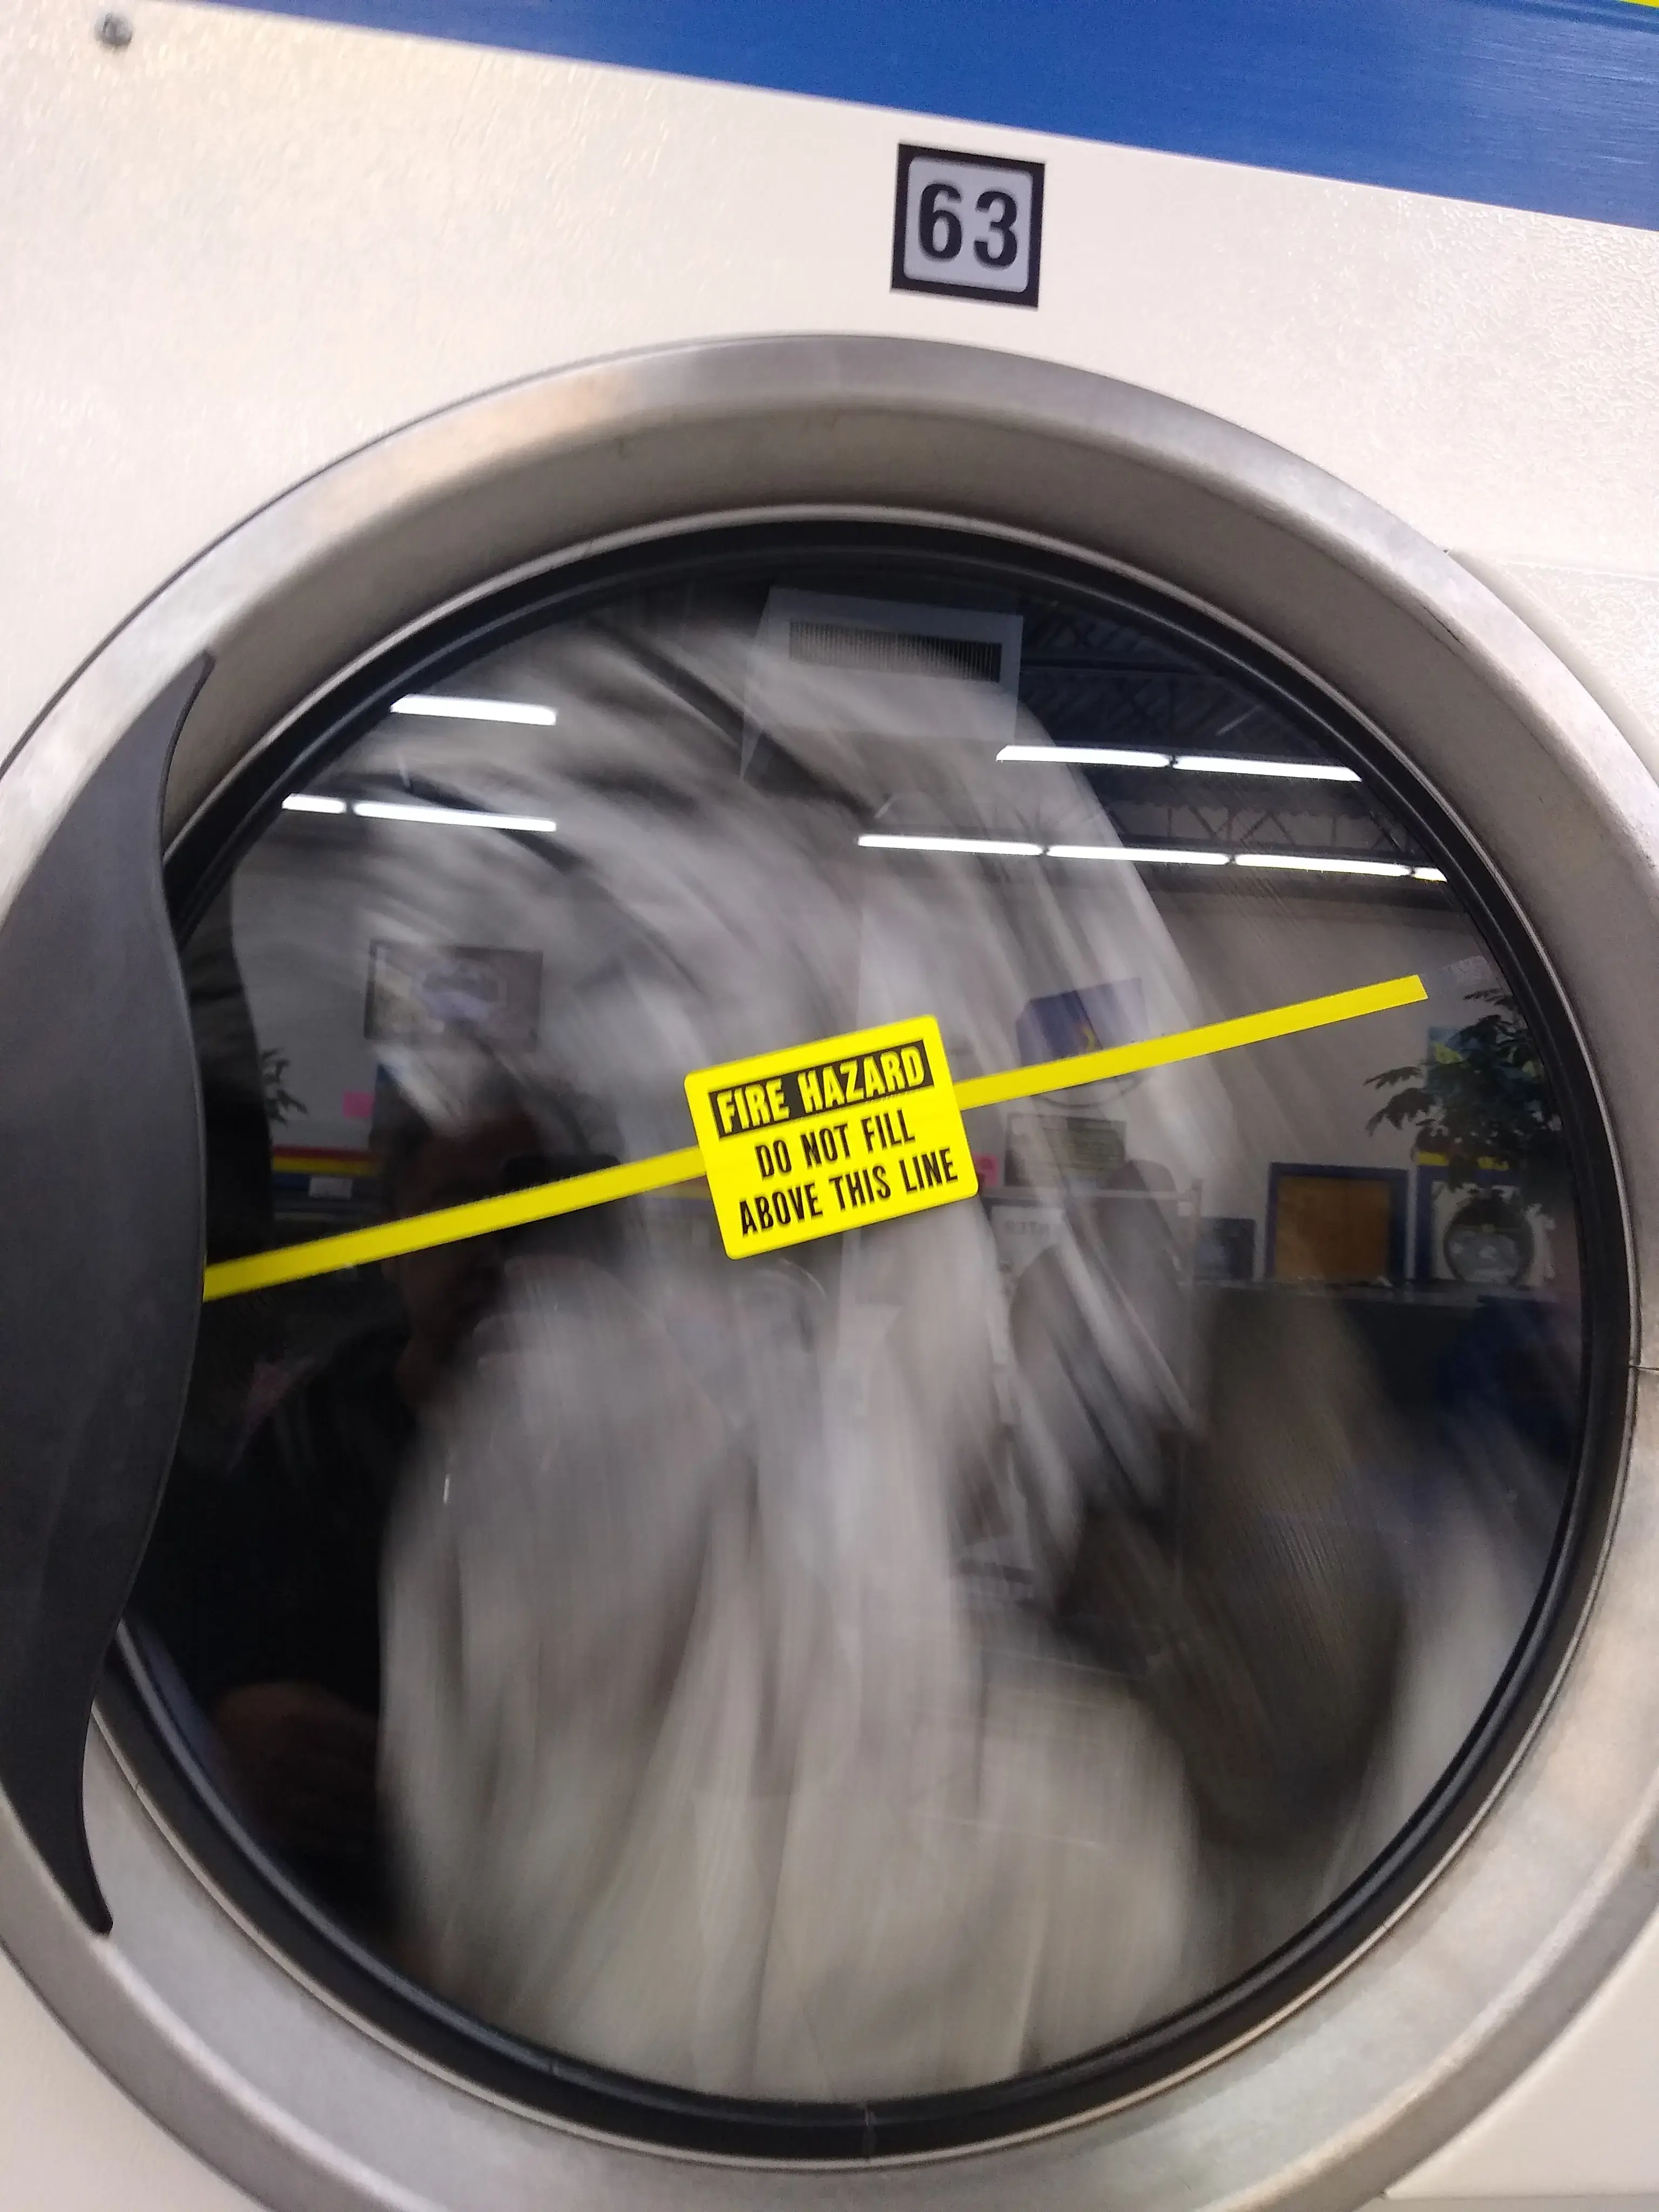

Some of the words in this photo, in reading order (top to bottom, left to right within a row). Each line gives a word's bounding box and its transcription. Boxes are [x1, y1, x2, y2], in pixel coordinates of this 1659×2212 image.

[919, 183, 1018, 268] 63
[716, 1077, 790, 1134] FIRE
[797, 1046, 925, 1113] HAZARD
[754, 1139, 792, 1181] DO
[799, 1123, 851, 1168] NOT
[860, 1108, 915, 1155] FILL
[738, 1182, 824, 1238] ABOVE
[828, 1164, 892, 1211] THIS
[899, 1147, 959, 1195] LINE
